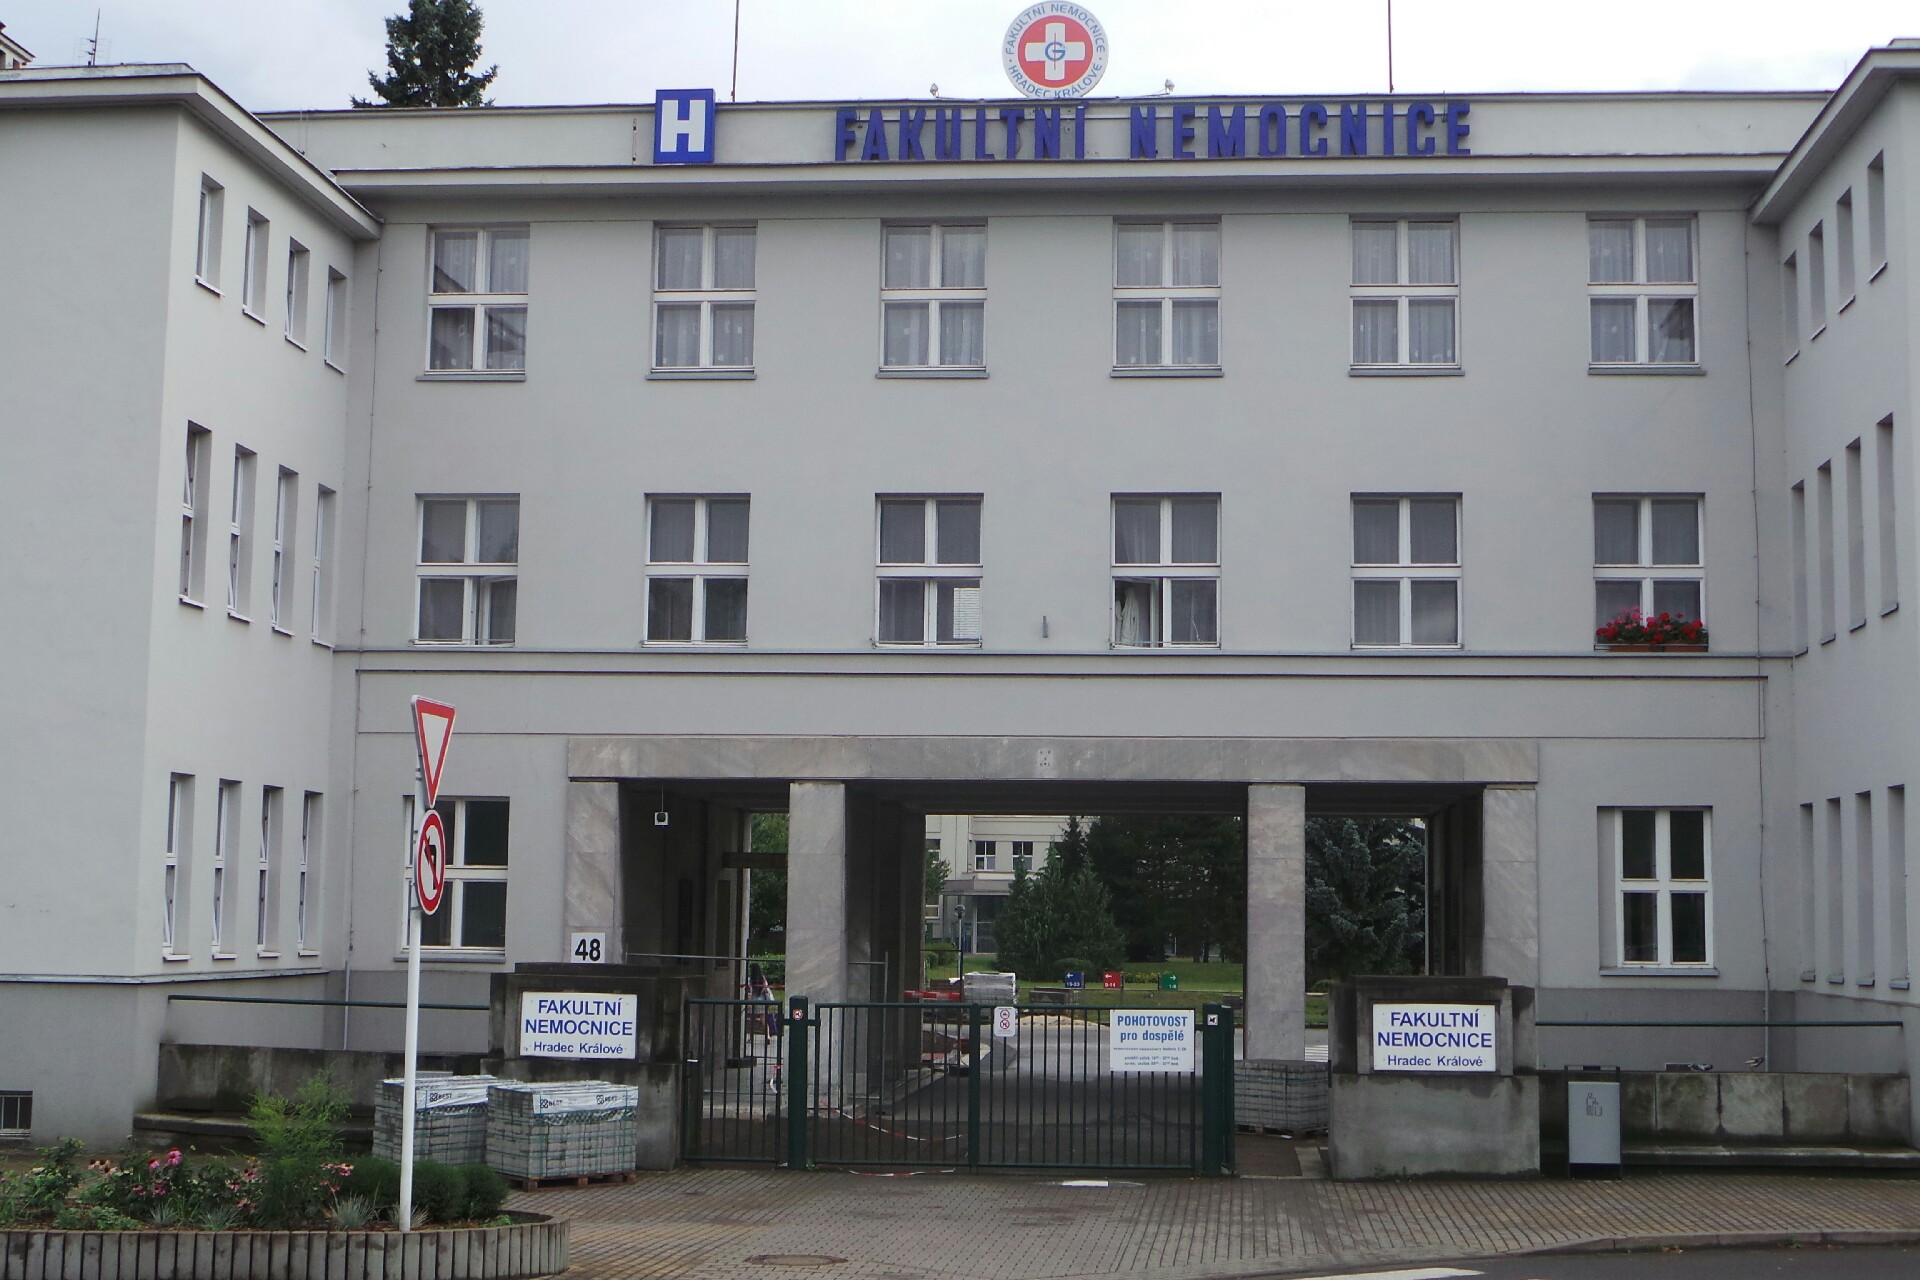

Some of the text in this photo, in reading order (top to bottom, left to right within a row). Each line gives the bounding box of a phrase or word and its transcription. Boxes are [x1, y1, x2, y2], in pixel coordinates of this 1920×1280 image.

[1051, 4, 1106, 53] NEMOCNICE
[1008, 65, 1051, 98] HRADEC
[660, 99, 706, 153] H
[1130, 103, 1471, 158] NEMOCNICE
[574, 938, 601, 962] 48
[538, 998, 622, 1016] FAKULTNÍ
[525, 1019, 633, 1036] NEMOCNICE
[1117, 1015, 1188, 1027] POHOTOVOST
[1390, 1009, 1479, 1028] FAKULTNÍ
[1120, 1029, 1184, 1043] pro dospělé
[1377, 1032, 1493, 1048] NEMOCNICE
[534, 1041, 623, 1054] Hradec Králové
[1387, 1055, 1483, 1067] Hradec Králové
